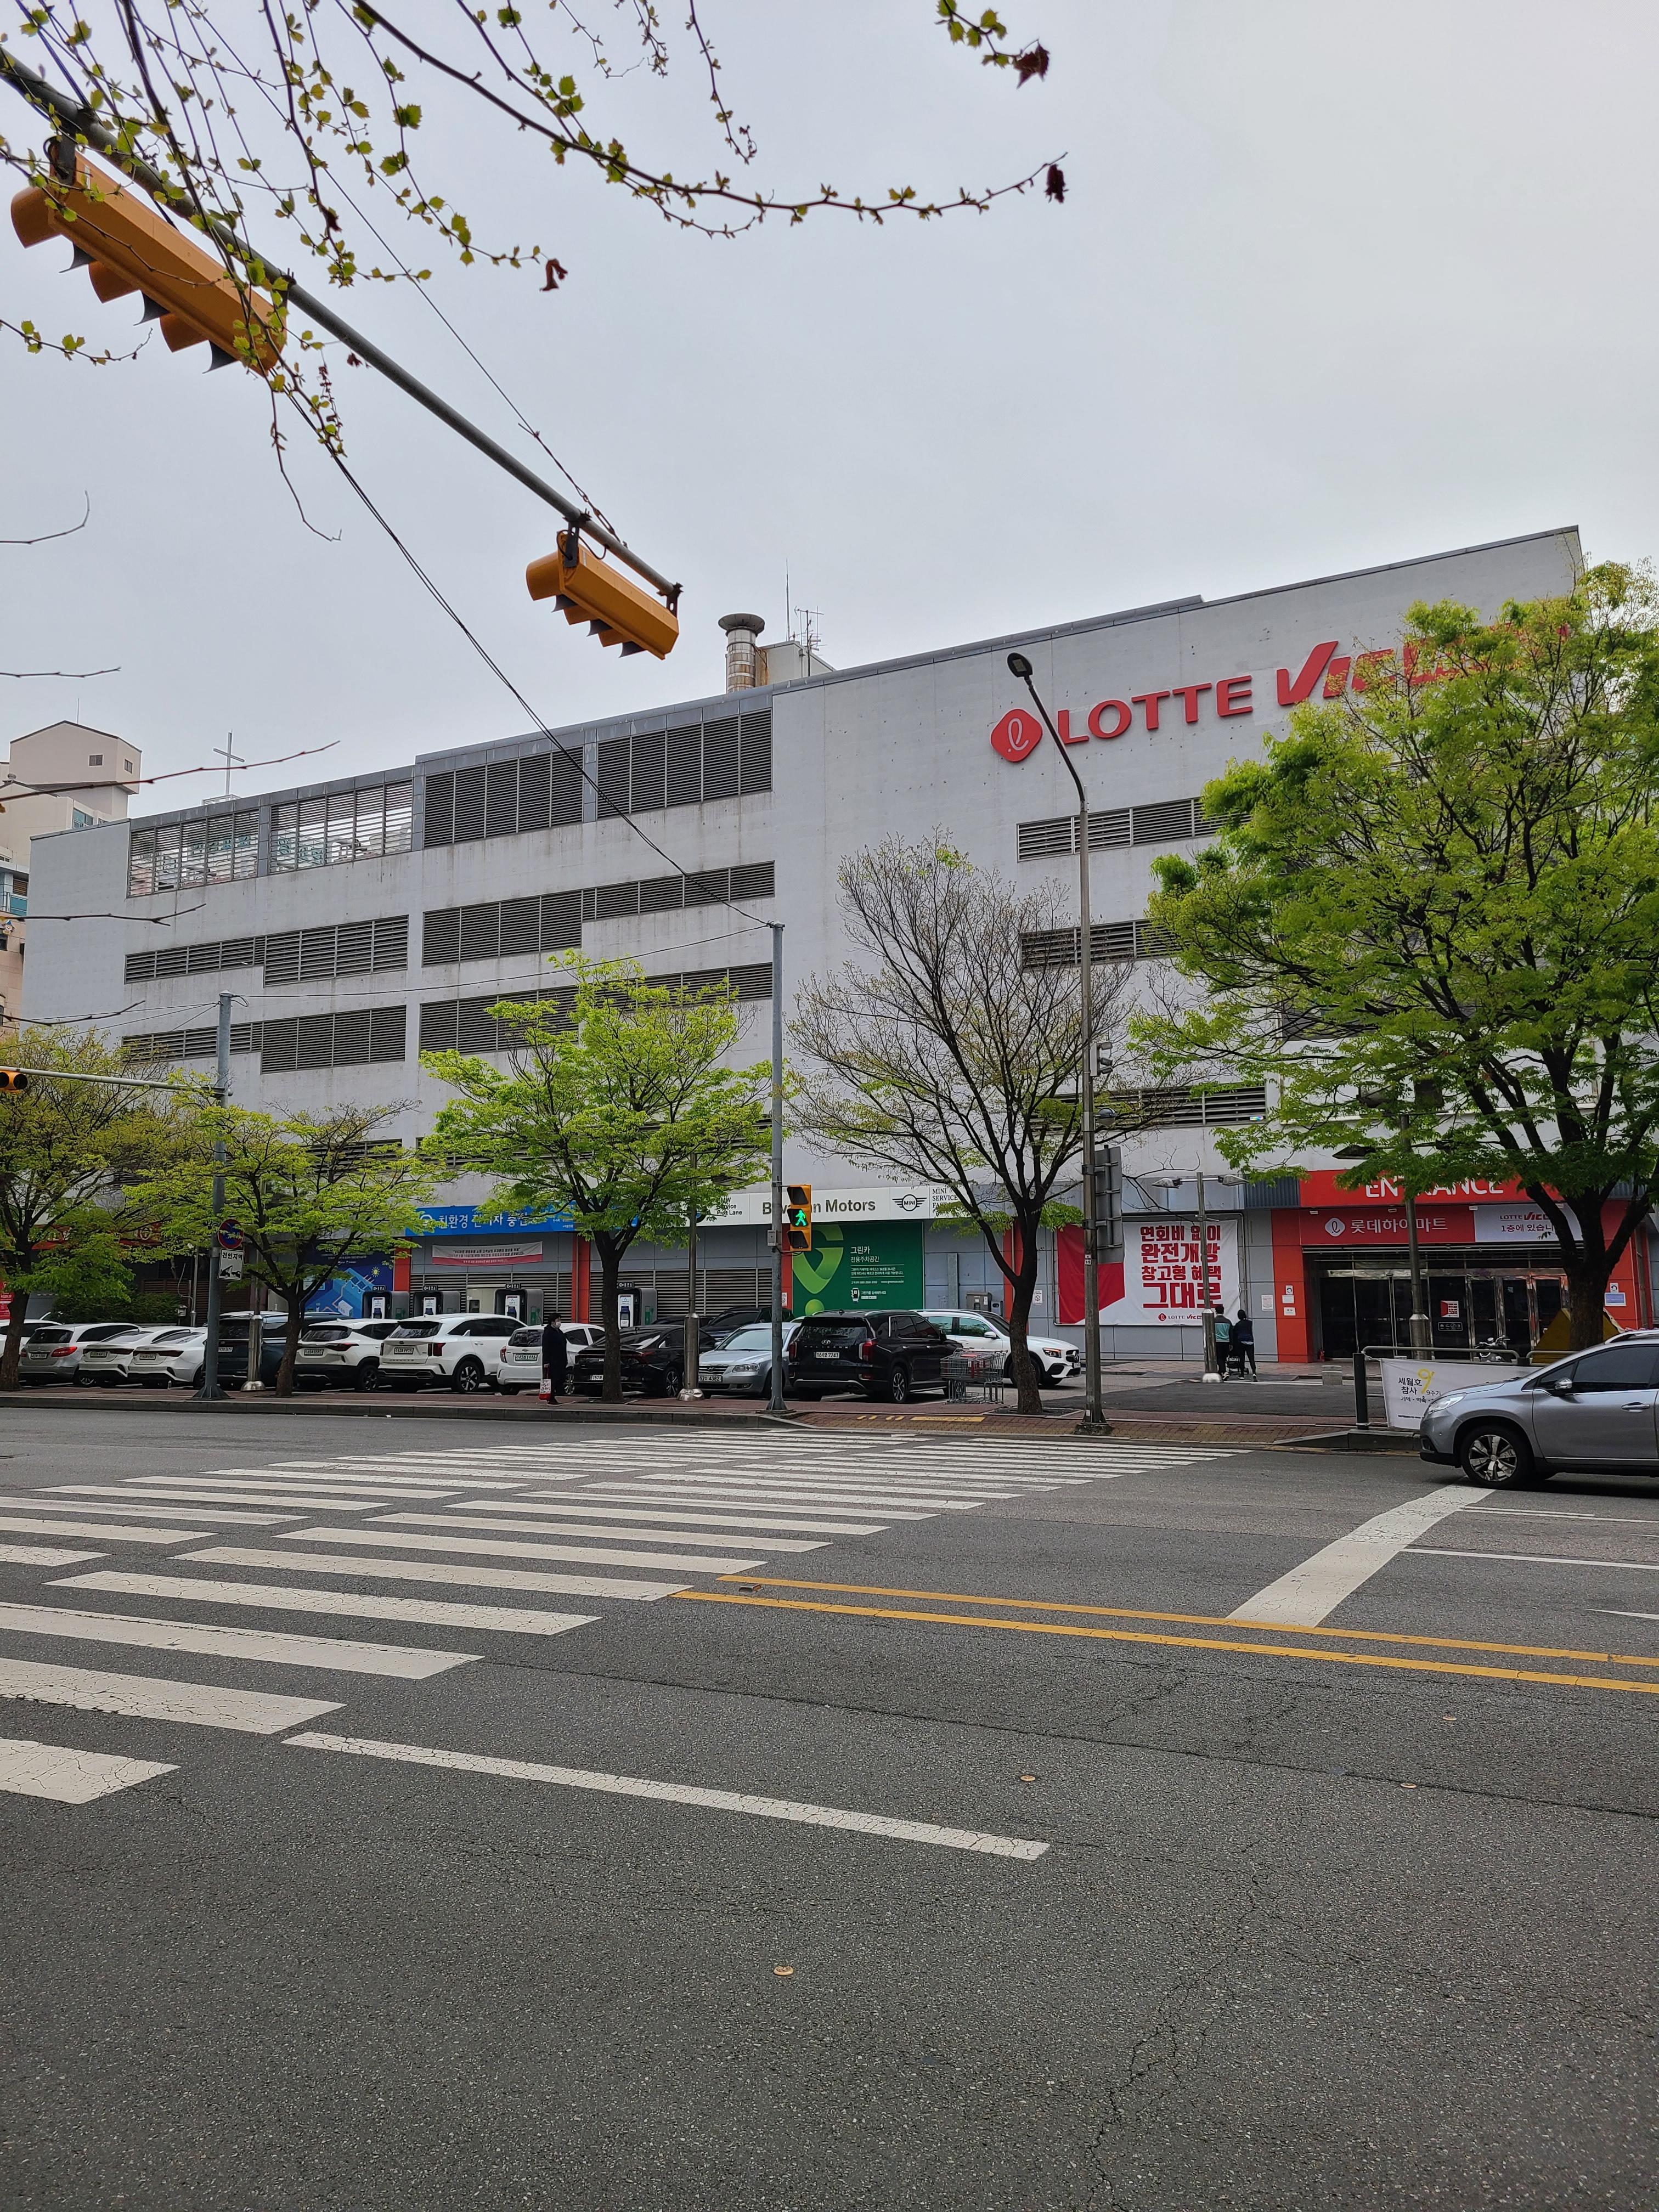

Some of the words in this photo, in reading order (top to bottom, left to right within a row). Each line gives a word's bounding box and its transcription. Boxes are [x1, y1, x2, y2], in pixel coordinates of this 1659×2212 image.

[1057, 675, 1253, 744] LOTTE
[1365, 1174, 1504, 1198] ENANCE
[825, 1199, 876, 1213] Motors
[1140, 1224, 1185, 1242] 연회비
[1501, 1224, 1524, 1233] 1층에
[1527, 1223, 1554, 1232] 있습니
[850, 1245, 871, 1255] 그린카
[1141, 1243, 1221, 1263] 완전개방
[1141, 1265, 1187, 1281] 창고형
[1191, 1265, 1222, 1281] 혜택
[1143, 1282, 1223, 1308] 그대로
[1398, 1377, 1423, 1386] 세월호
[1401, 1386, 1417, 1395] 참사
